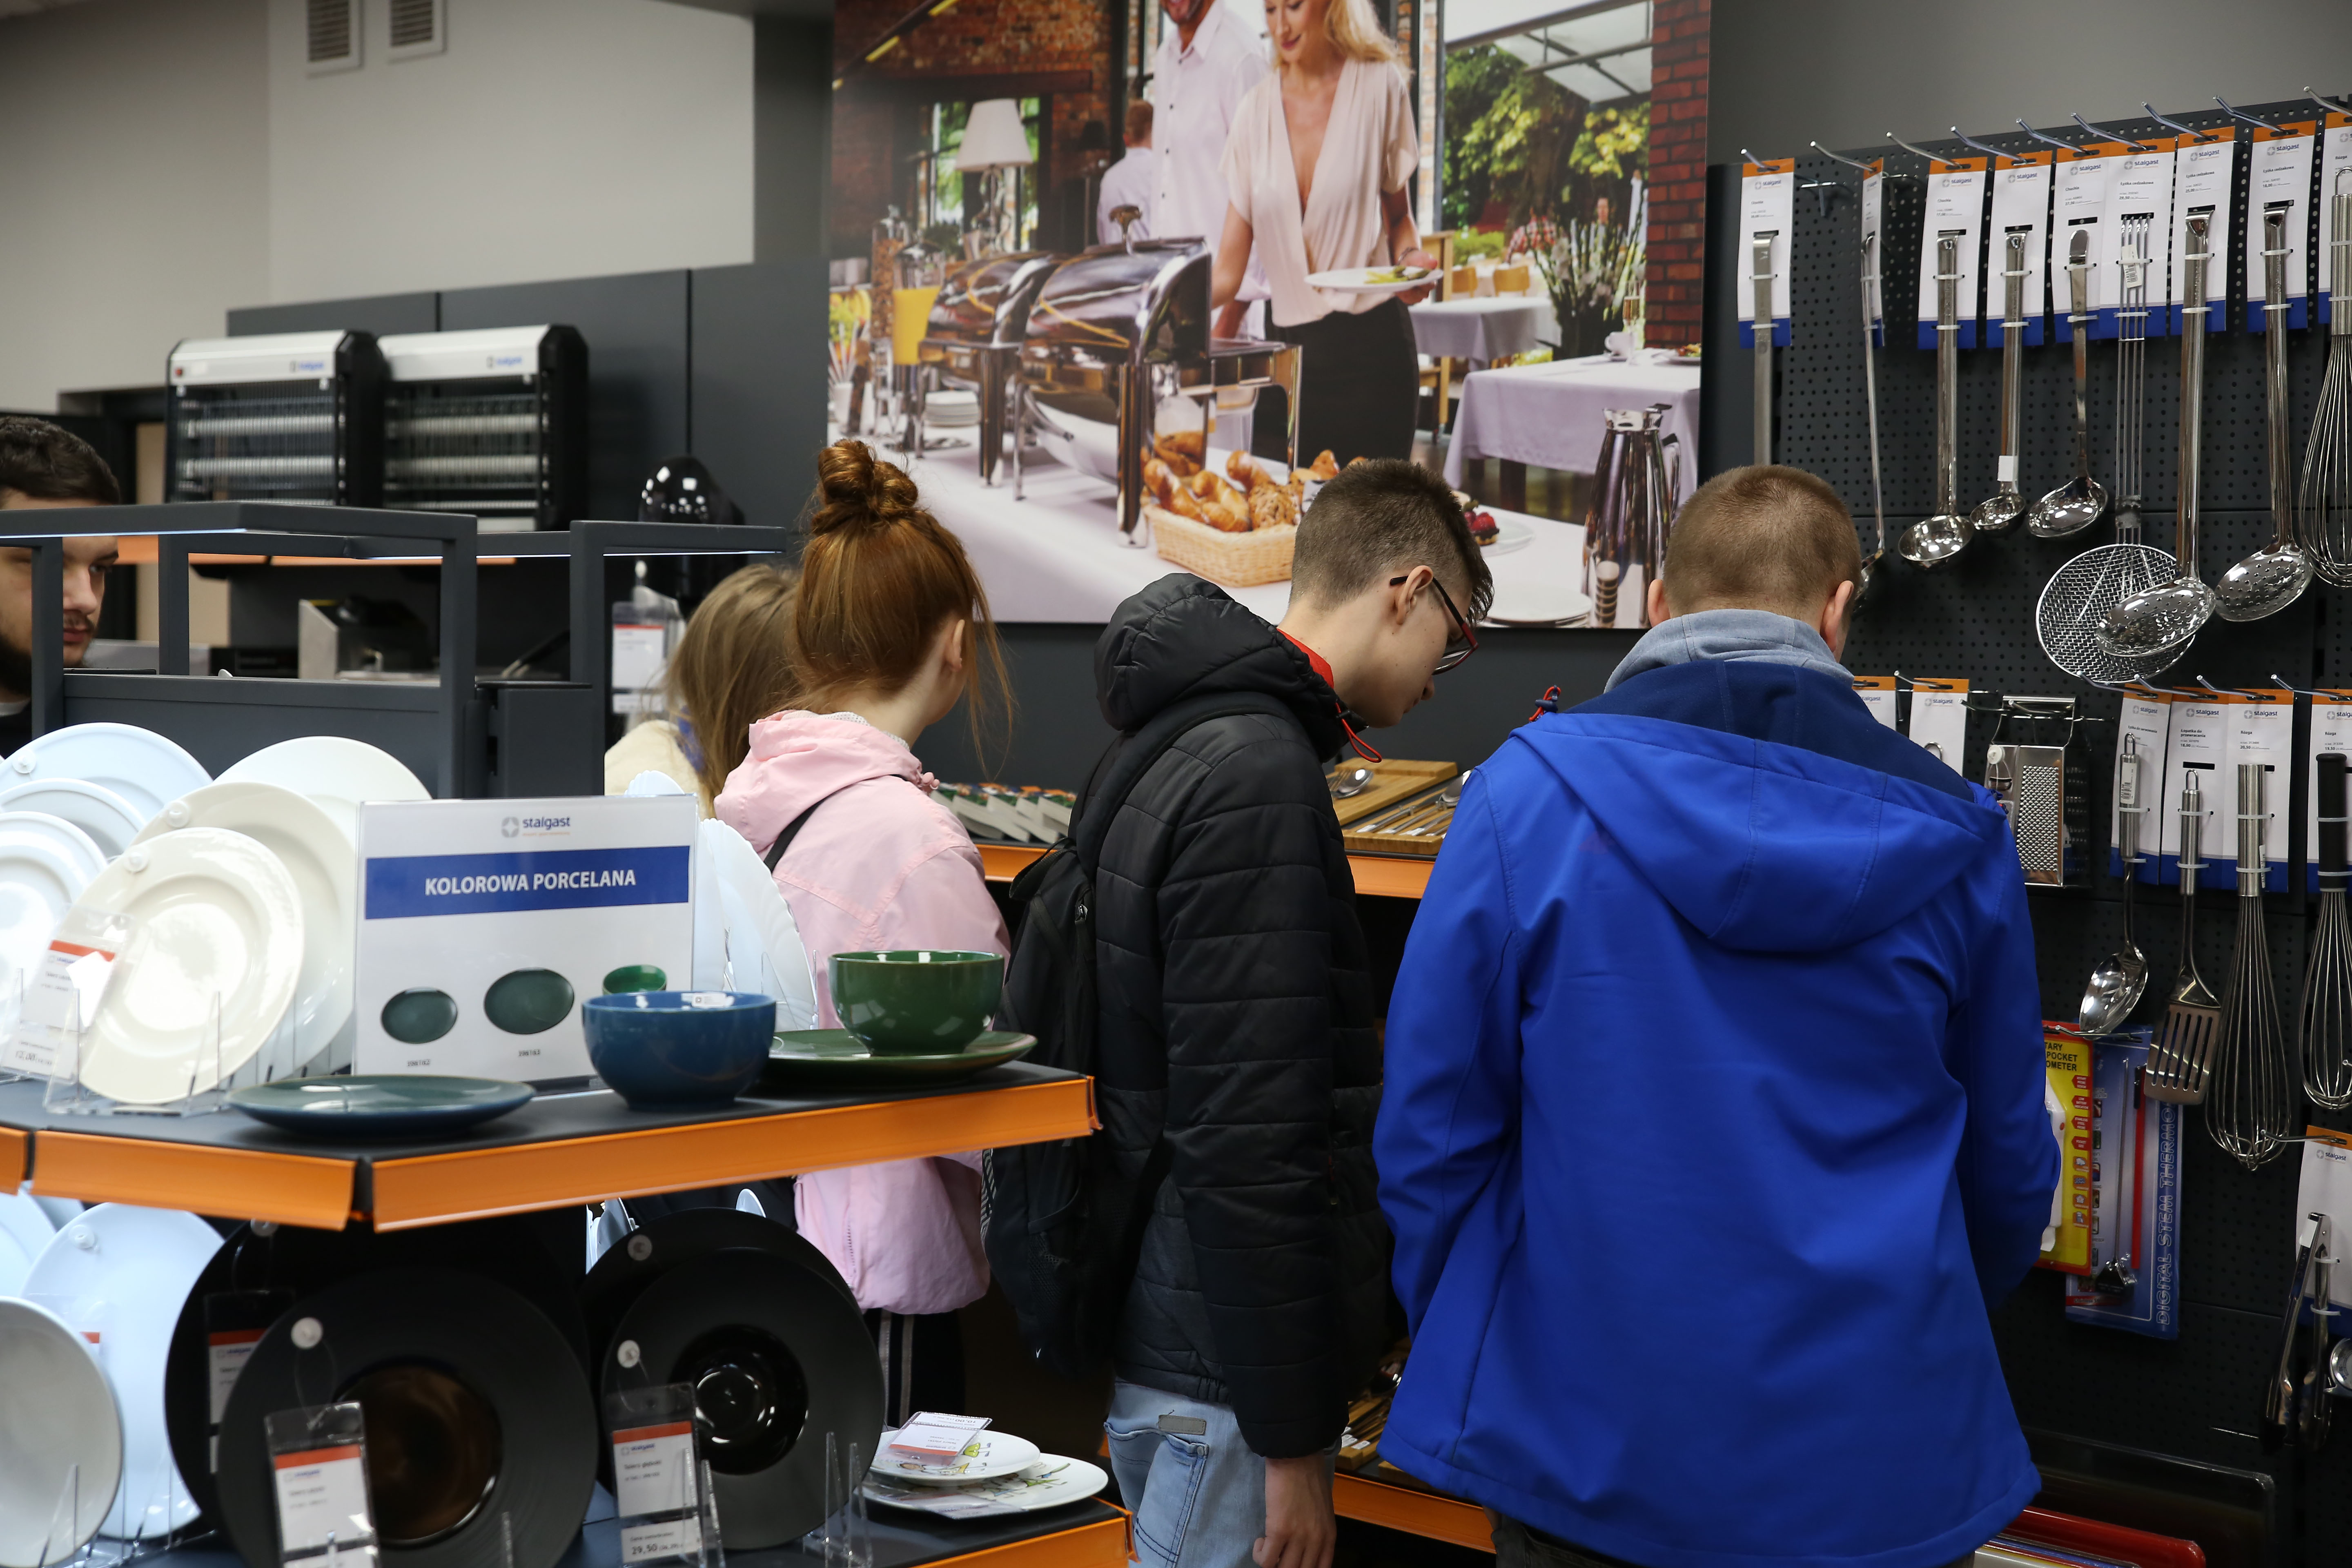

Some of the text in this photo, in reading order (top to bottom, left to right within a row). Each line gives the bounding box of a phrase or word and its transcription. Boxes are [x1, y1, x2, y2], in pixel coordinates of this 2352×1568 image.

[522, 817, 570, 830] stalgast
[425, 869, 636, 895] KOLOROWA PORCELANA
[2045, 1042, 2062, 1051] TARY
[2047, 1051, 2078, 1062] POCKET
[2046, 1060, 2077, 1071] OMETER
[2325, 1152, 2346, 1160] stalgast
[2156, 1101, 2176, 1325] DIGITAL STEM THERMO
